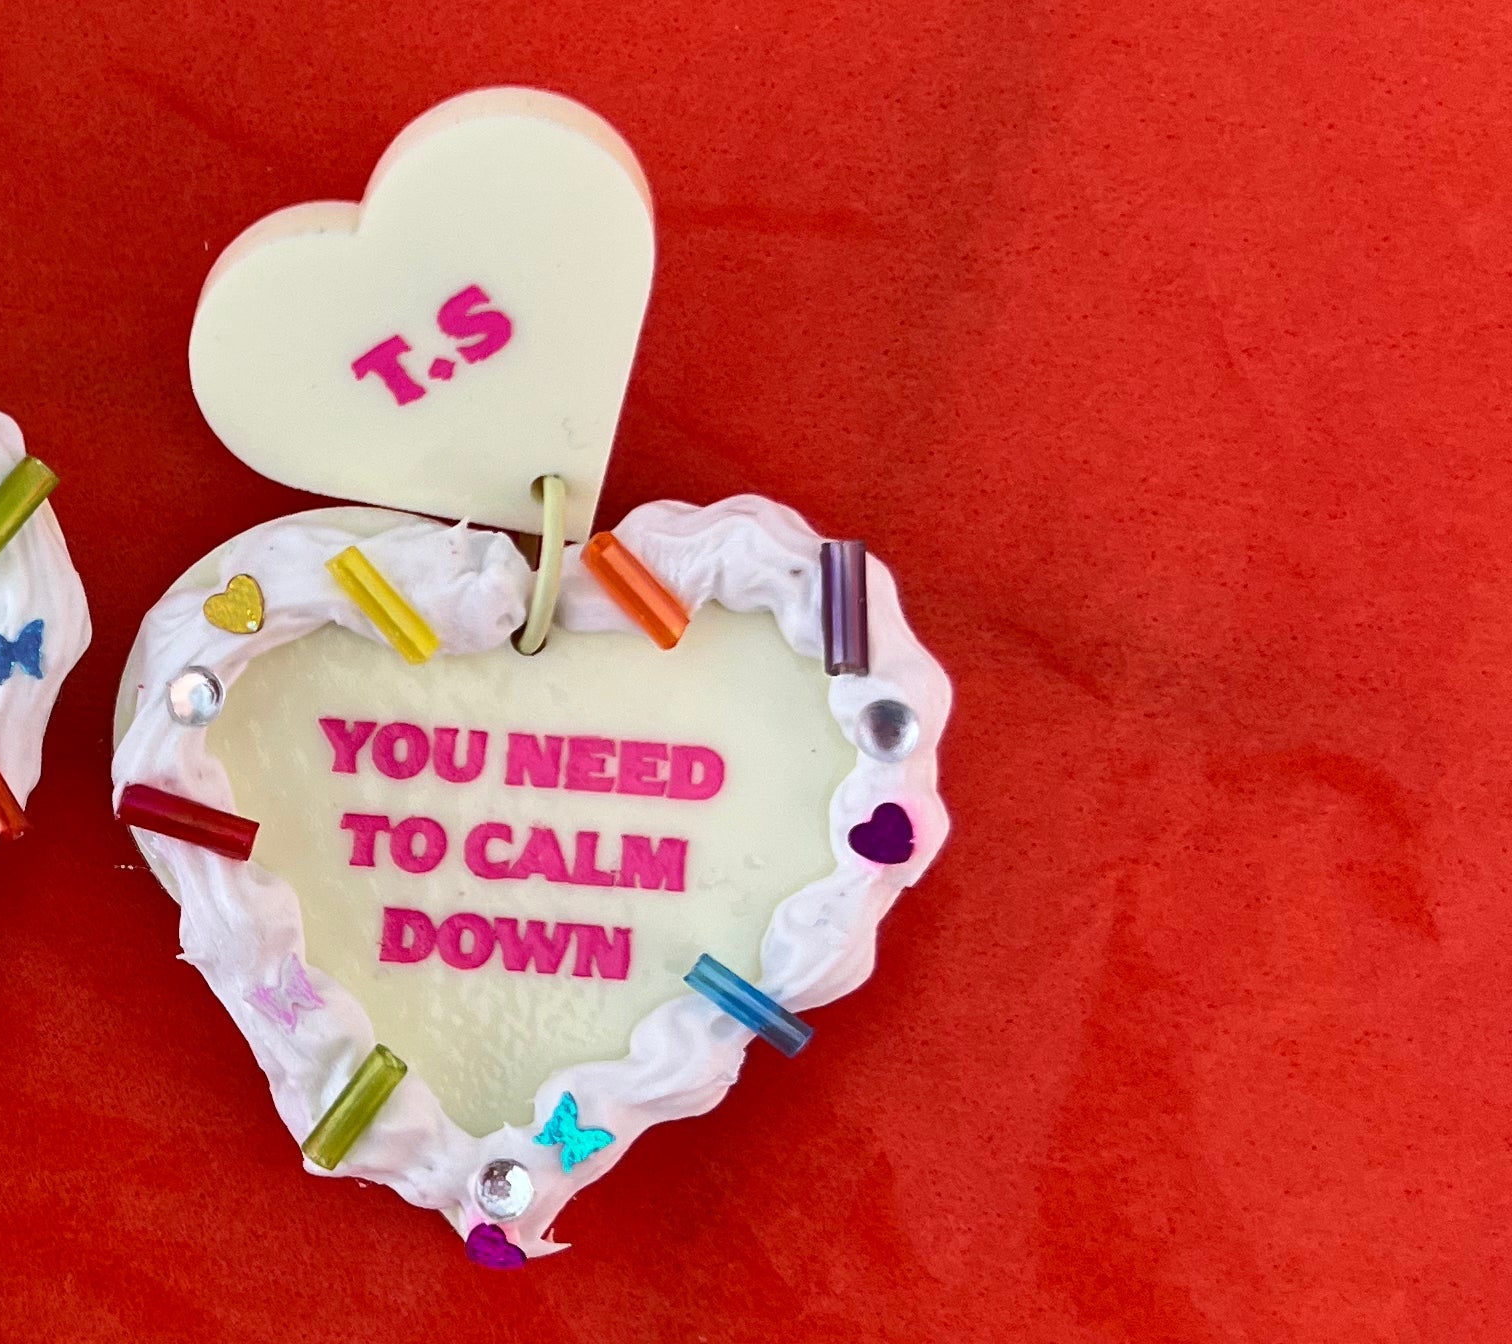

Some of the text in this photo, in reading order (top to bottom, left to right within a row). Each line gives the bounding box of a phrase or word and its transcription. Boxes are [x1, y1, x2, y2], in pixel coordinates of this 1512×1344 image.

[351, 283, 515, 408] T.S
[318, 716, 727, 803] YOU NEED
[340, 813, 688, 895] TO CALM
[379, 905, 633, 982] DOWN
